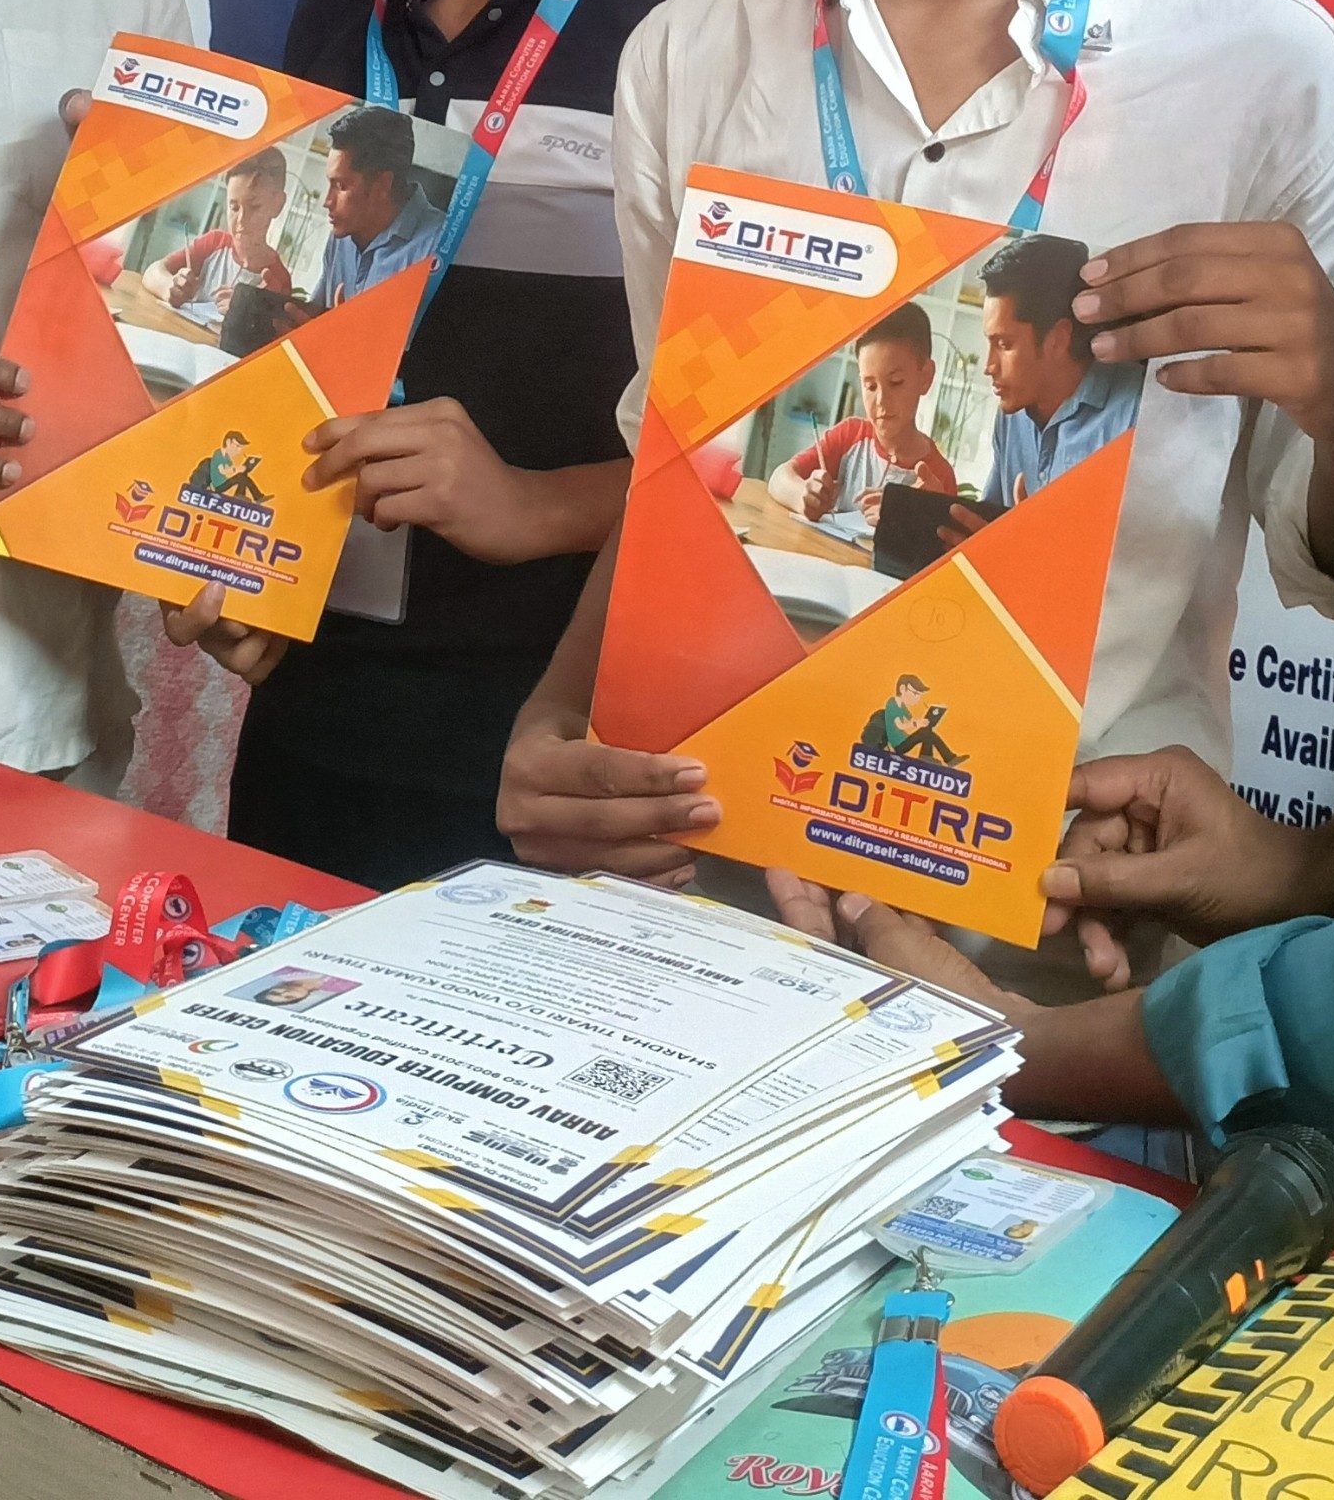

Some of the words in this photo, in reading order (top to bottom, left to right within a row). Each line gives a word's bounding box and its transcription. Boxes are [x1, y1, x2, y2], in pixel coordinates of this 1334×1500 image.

[496, 77, 515, 106] AARAV
[509, 37, 536, 78] COMPUTER
[503, 69, 529, 113] EDUCATION
[526, 38, 547, 70] CENTER
[538, 134, 606, 161] sports
[461, 175, 480, 207] CENTER
[180, 490, 271, 526] SELF-STUDY
[138, 547, 262, 591] www.ditrpself-study.com
[853, 752, 968, 795] SELF-STUDY
[799, 803, 846, 822] INFORMATION
[847, 815, 894, 837] TECHNOLOGY
[900, 832, 938, 849] RESEARCH
[938, 843, 953, 854] FOR
[953, 847, 1008, 870] PROFESSIONAL
[810, 825, 966, 881] www.ditrpself-study.com
[113, 891, 138, 948] CENTER
[489, 912, 541, 929] CENTER
[541, 925, 618, 949] EDUCATION
[303, 951, 367, 969] TIWARI
[616, 945, 693, 972] COMPUTER
[370, 965, 439, 986] KUMAR
[694, 967, 744, 986] AARAV
[440, 983, 500, 1003] VINOD
[180, 1002, 271, 1030] CENTER
[506, 1000, 545, 1015] D/O
[290, 1013, 370, 1038] Organization
[344, 1002, 554, 1070] Certificate
[547, 1013, 615, 1037] TIWARI
[266, 1022, 399, 1068] EDUCATION
[371, 1034, 429, 1057] Certified
[621, 1034, 717, 1071] SHARDHA
[430, 1053, 500, 1080] 9001:2015
[395, 1059, 530, 1109] COMPUTER
[502, 1076, 532, 1087] ISO
[531, 1085, 549, 1095] An
[527, 1105, 619, 1141] AARAV
[724, 1454, 841, 1497] Roy
